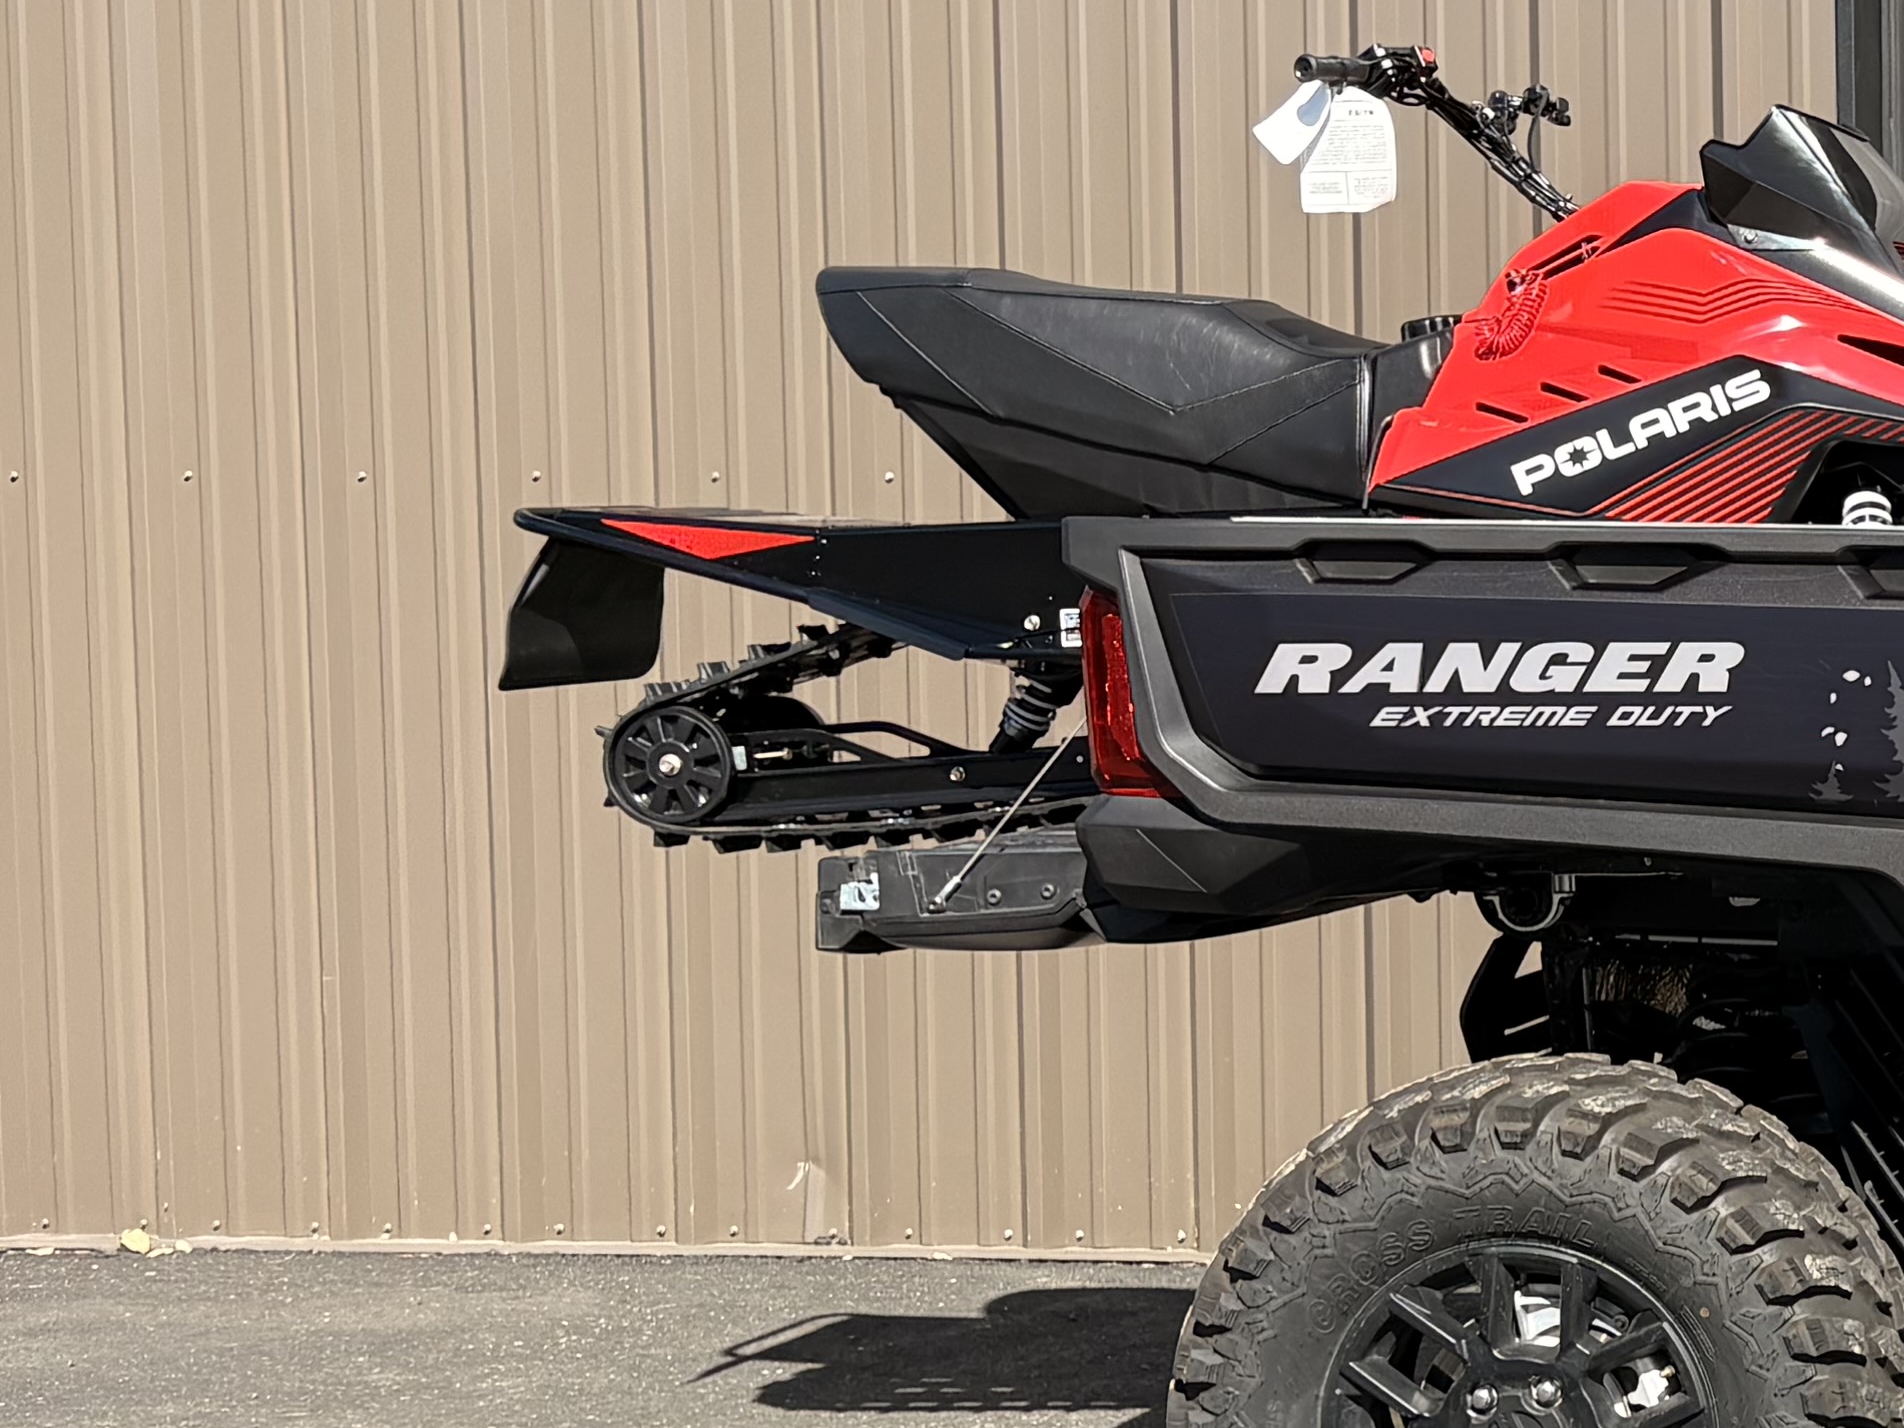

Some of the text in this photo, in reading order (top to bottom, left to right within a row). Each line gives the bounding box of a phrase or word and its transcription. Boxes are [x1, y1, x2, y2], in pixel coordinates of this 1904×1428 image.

[1510, 369, 1771, 496] POLARIS
[1254, 641, 1745, 694] RANGER
[1369, 705, 1733, 727] EXTREME DUTY
[1308, 1204, 1596, 1333] CROSS TRAIL
